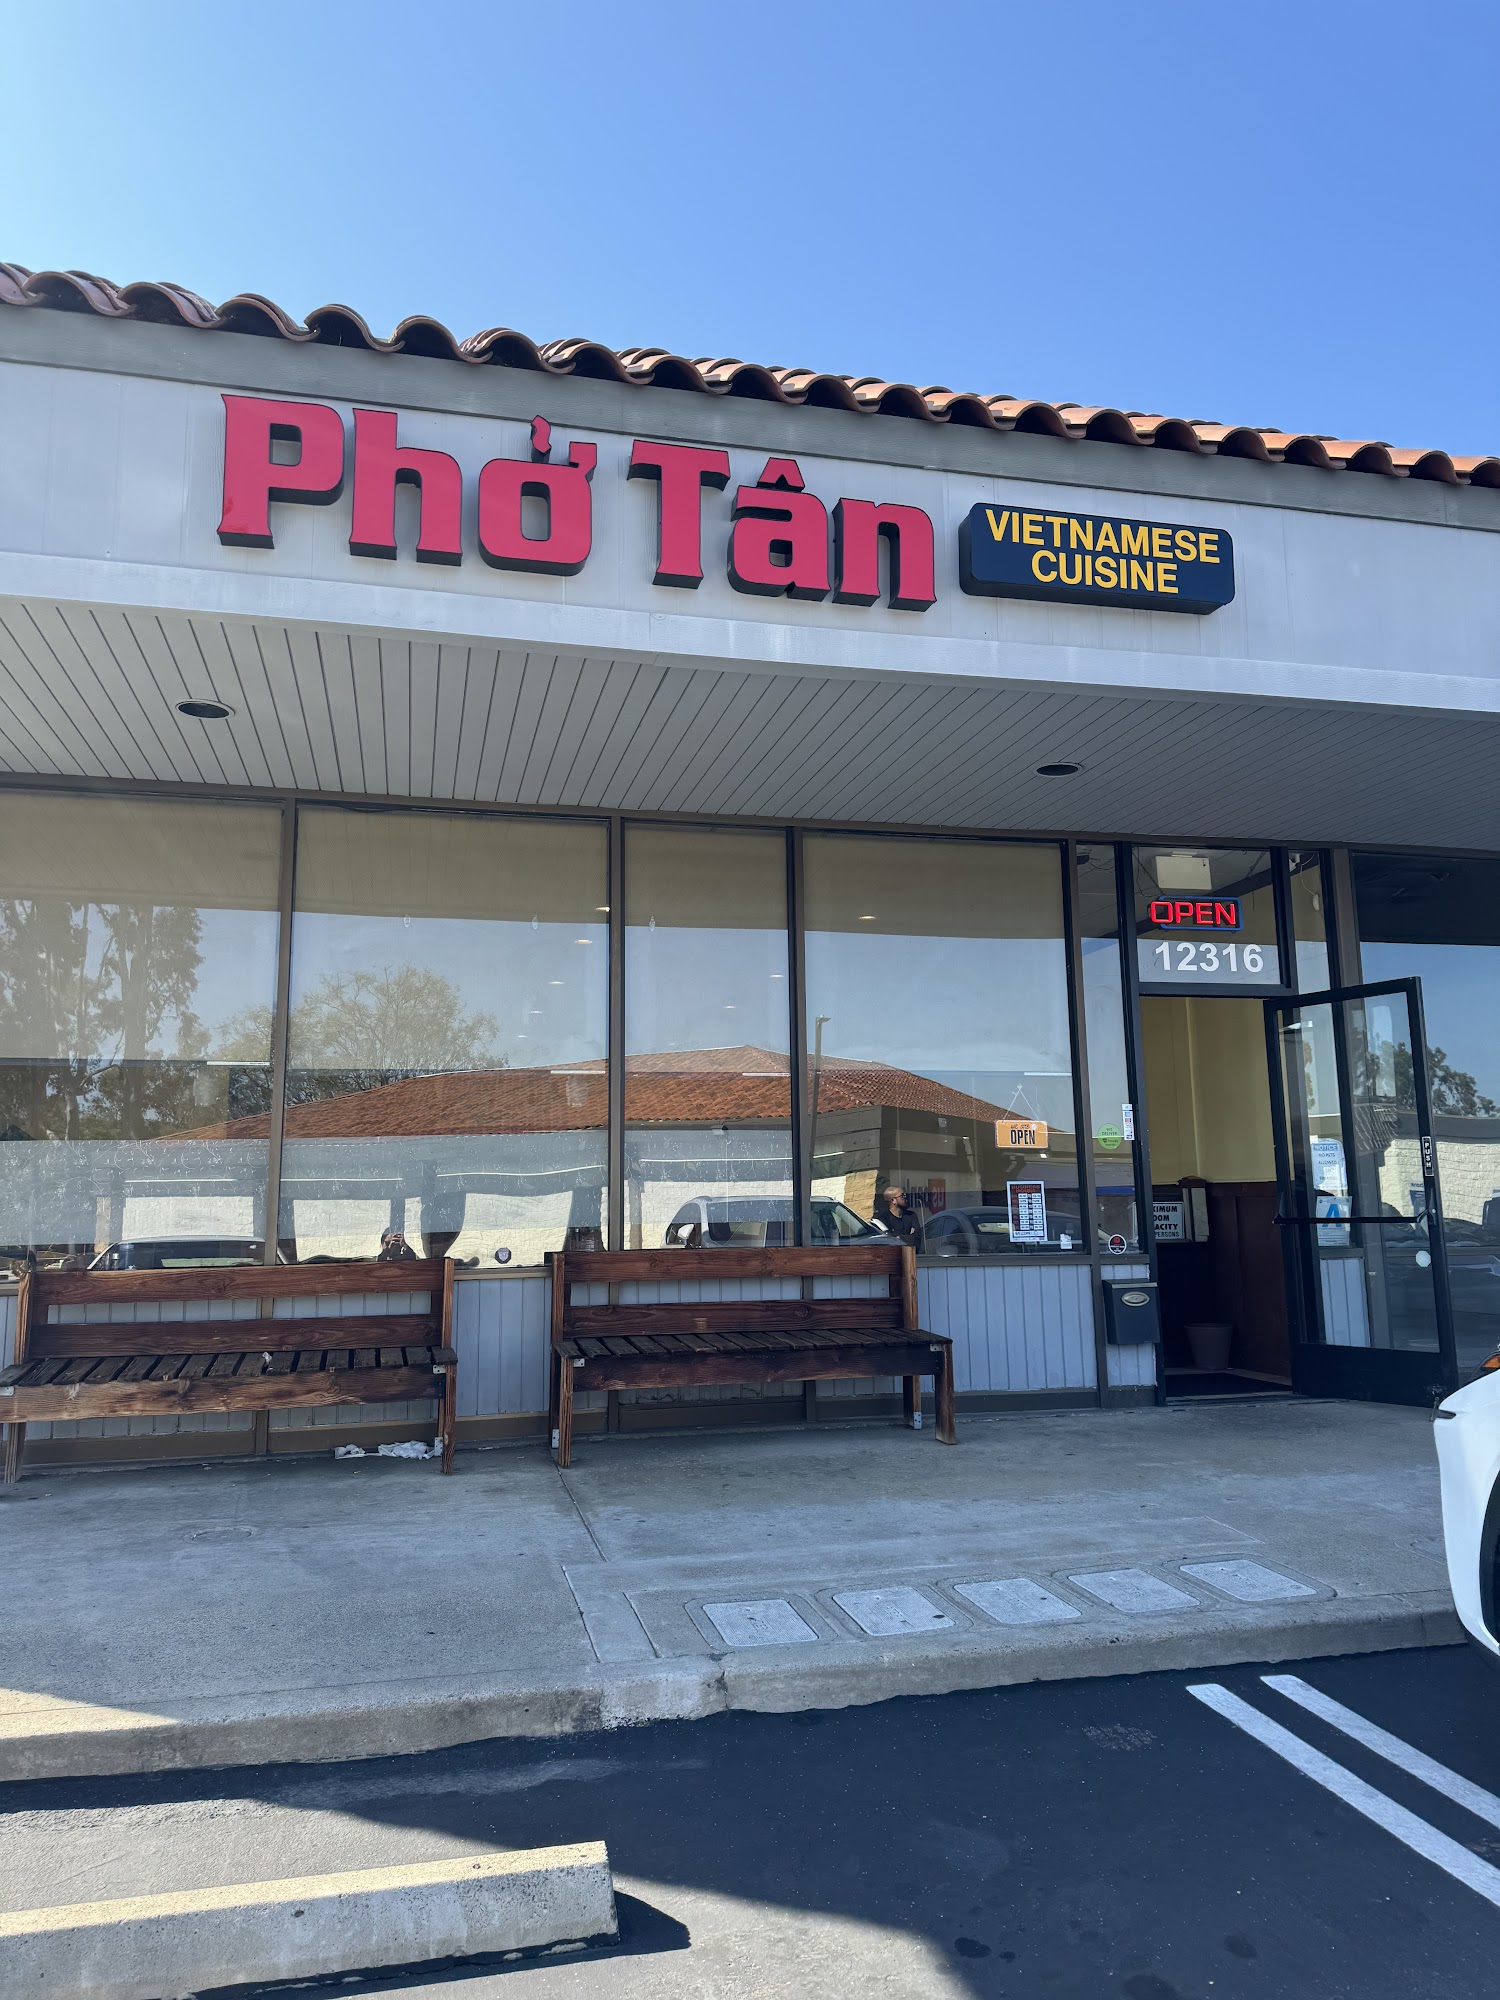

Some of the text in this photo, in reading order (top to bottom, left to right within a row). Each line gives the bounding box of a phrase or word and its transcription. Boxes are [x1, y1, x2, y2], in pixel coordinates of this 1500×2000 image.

[217, 394, 937, 611] Phở Tân
[985, 508, 1220, 564] VIETNAMESE
[1031, 549, 1179, 593] CUISINE
[1150, 901, 1237, 925] OPEN
[1155, 942, 1264, 973] 12316
[1011, 1129, 1035, 1145] OPEN
[1322, 1204, 1343, 1227] A
